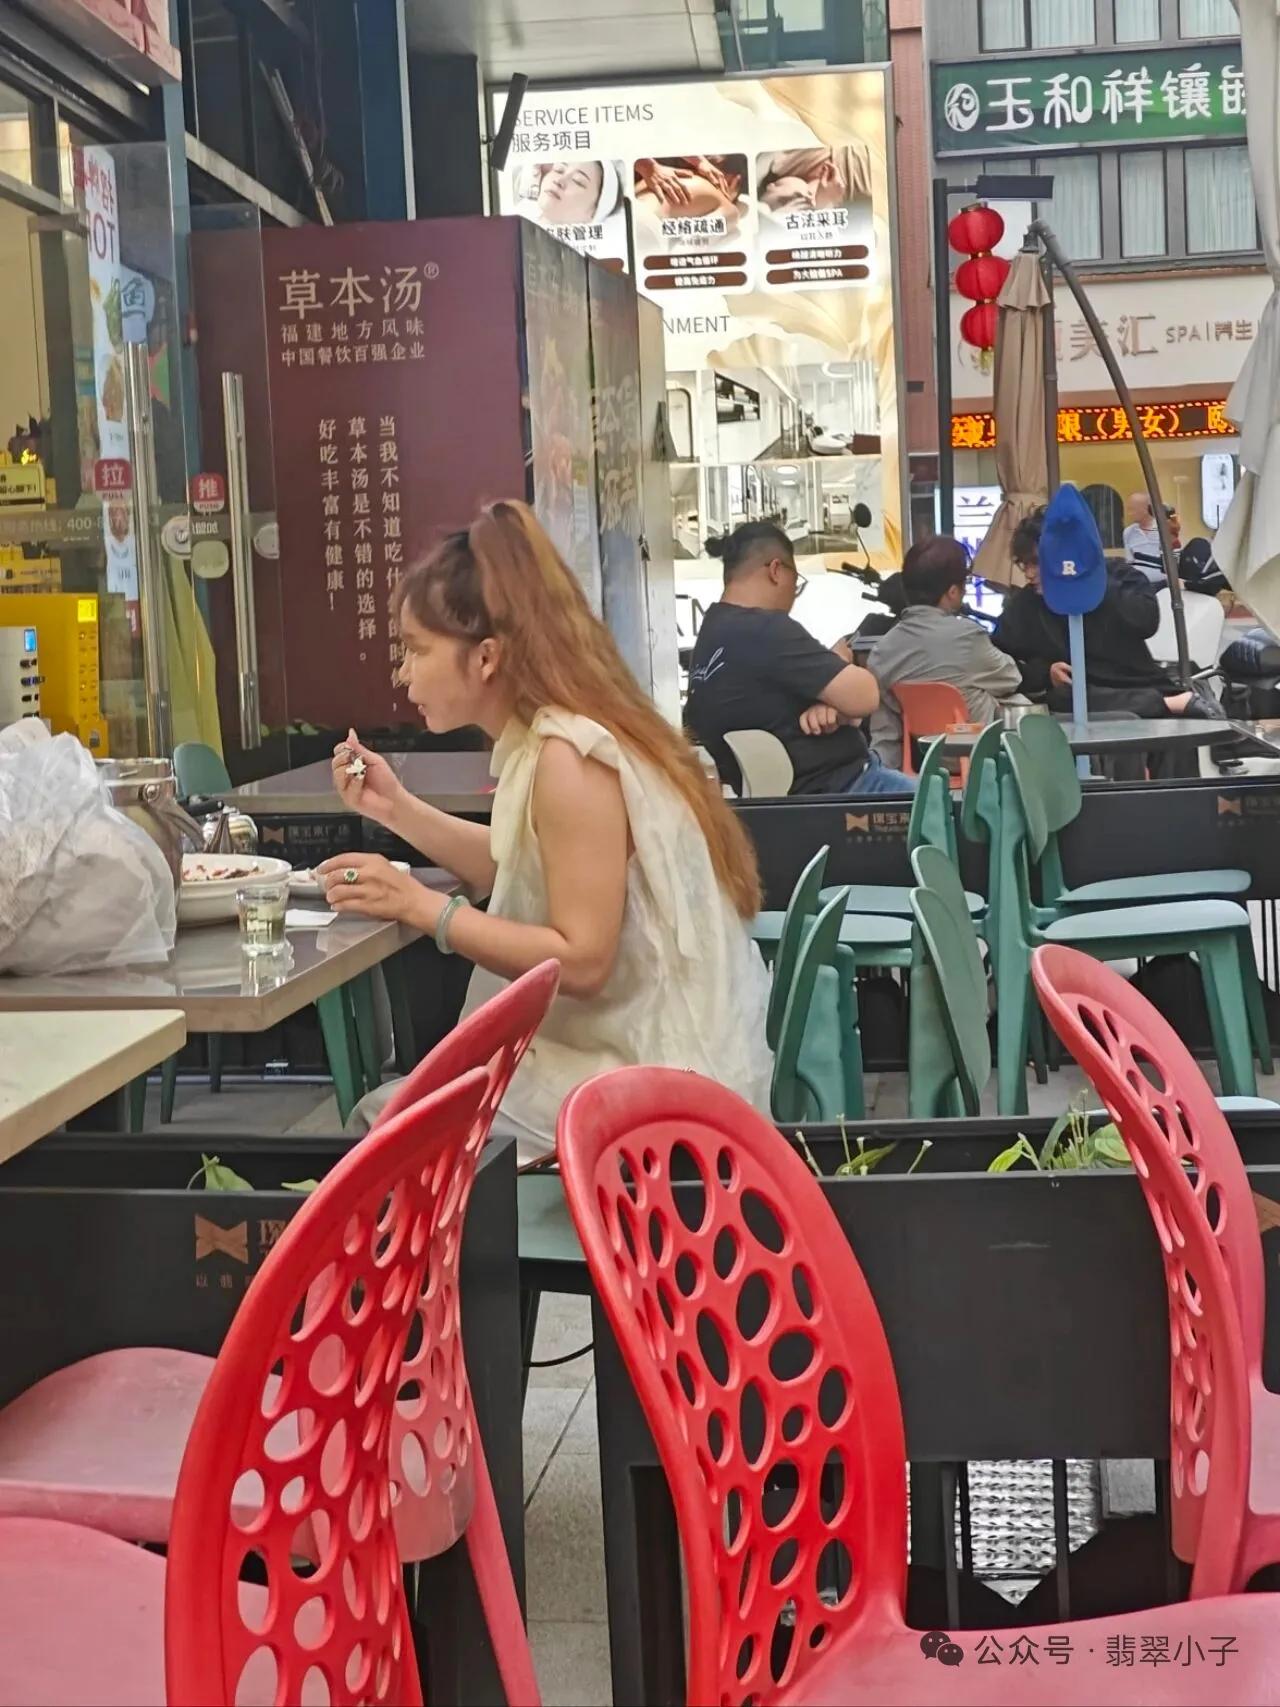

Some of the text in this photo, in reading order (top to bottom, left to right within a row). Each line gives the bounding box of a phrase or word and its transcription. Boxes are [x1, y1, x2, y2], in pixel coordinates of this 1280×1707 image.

[595, 103, 654, 123] ITEMS
[513, 130, 591, 152] 服务项目
[785, 211, 847, 231] 古法采耳
[546, 224, 603, 241] 肤管理
[279, 266, 422, 320] 草本汤
[281, 317, 425, 344] 福建地方风味
[1165, 325, 1201, 344] SPA
[281, 341, 426, 368] 中国餐饮百强企业
[102, 463, 125, 487] 拉
[198, 478, 219, 499] 推
[348, 416, 377, 662] 草本汤是不错的选择。
[379, 415, 407, 713] 当我不知道吃什的时，
[1062, 561, 1077, 576] R
